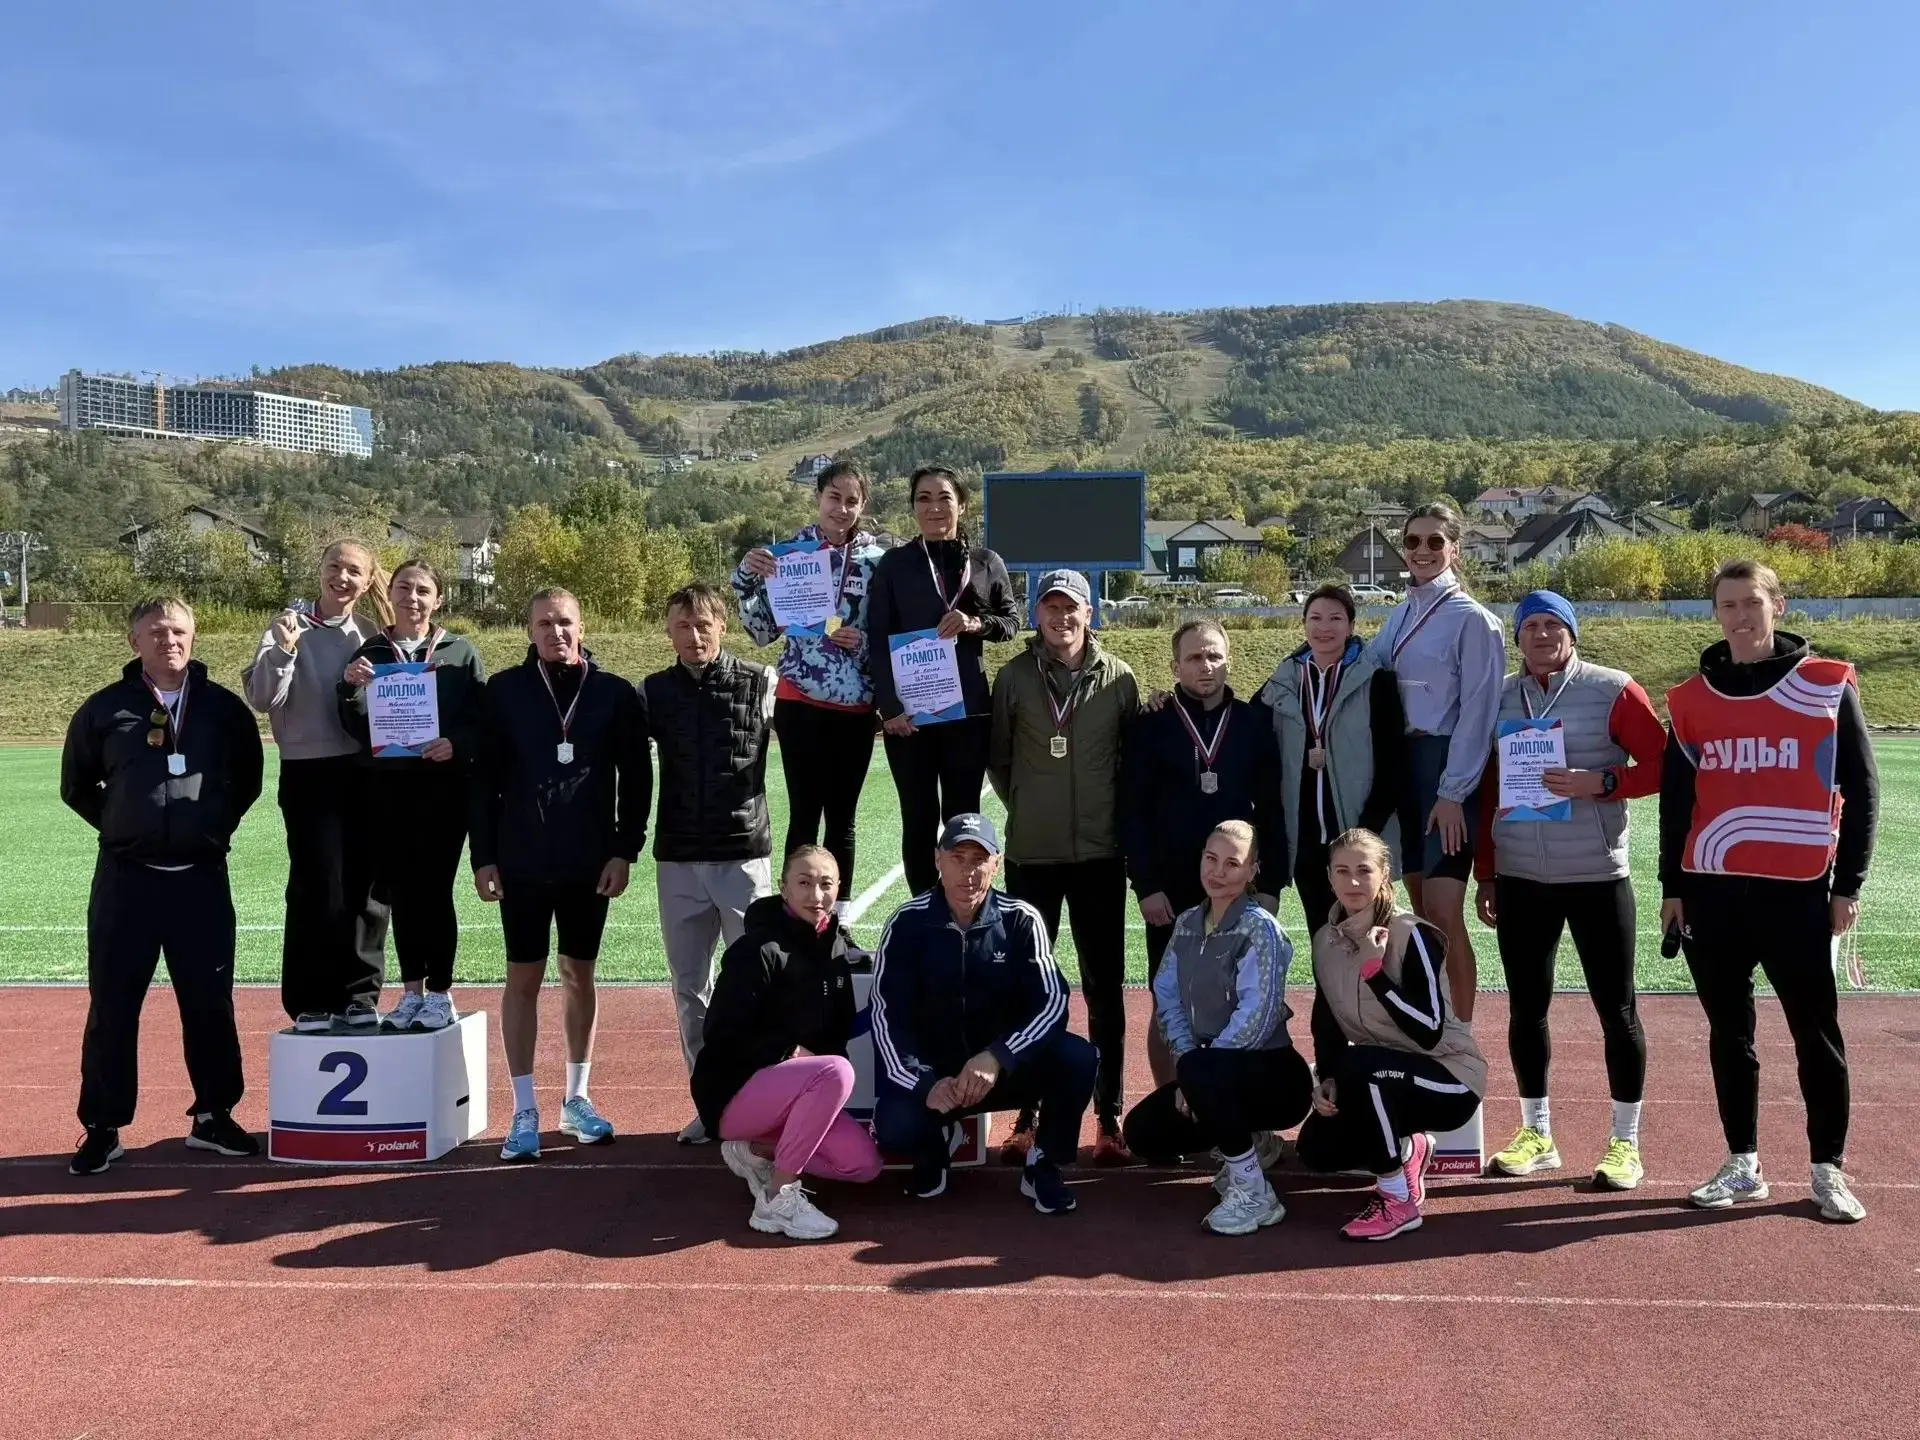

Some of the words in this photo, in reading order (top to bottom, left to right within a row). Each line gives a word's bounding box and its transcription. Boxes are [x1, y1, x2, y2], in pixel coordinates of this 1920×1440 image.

[775, 562, 822, 578] РАМОТА
[900, 647, 946, 667] ГРАМОТА
[377, 684, 426, 698] ДИПЛОМ
[1509, 740, 1554, 756] ДИПЛОМ
[1700, 737, 1798, 773] СУДЬЯ
[316, 1051, 368, 1115] 2
[377, 1140, 420, 1153] polanik
[1442, 1160, 1475, 1173] polanik
